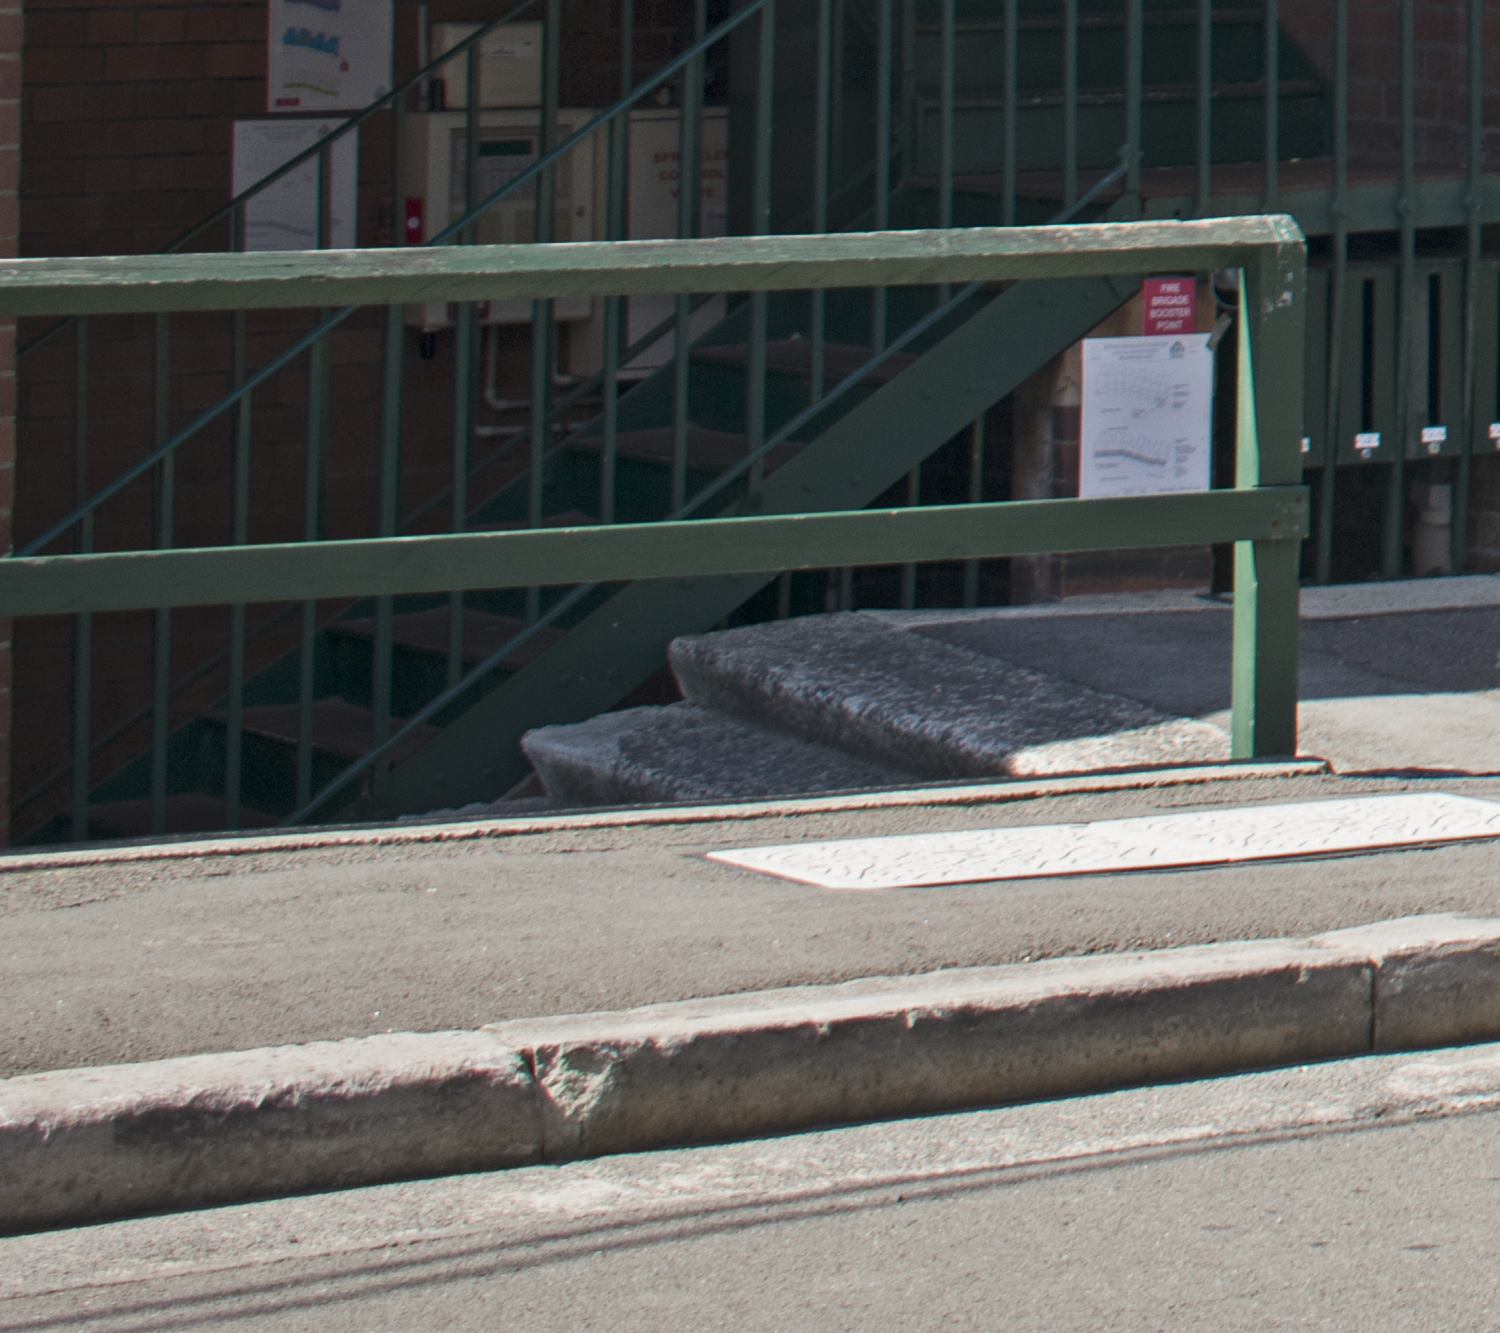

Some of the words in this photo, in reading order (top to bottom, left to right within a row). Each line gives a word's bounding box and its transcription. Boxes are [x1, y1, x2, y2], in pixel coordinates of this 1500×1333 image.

[1161, 282, 1181, 293] FIRE
[1151, 295, 1190, 306] BRIGADE
[1150, 307, 1191, 319] BOOSTER
[1156, 319, 1184, 330] POINT
